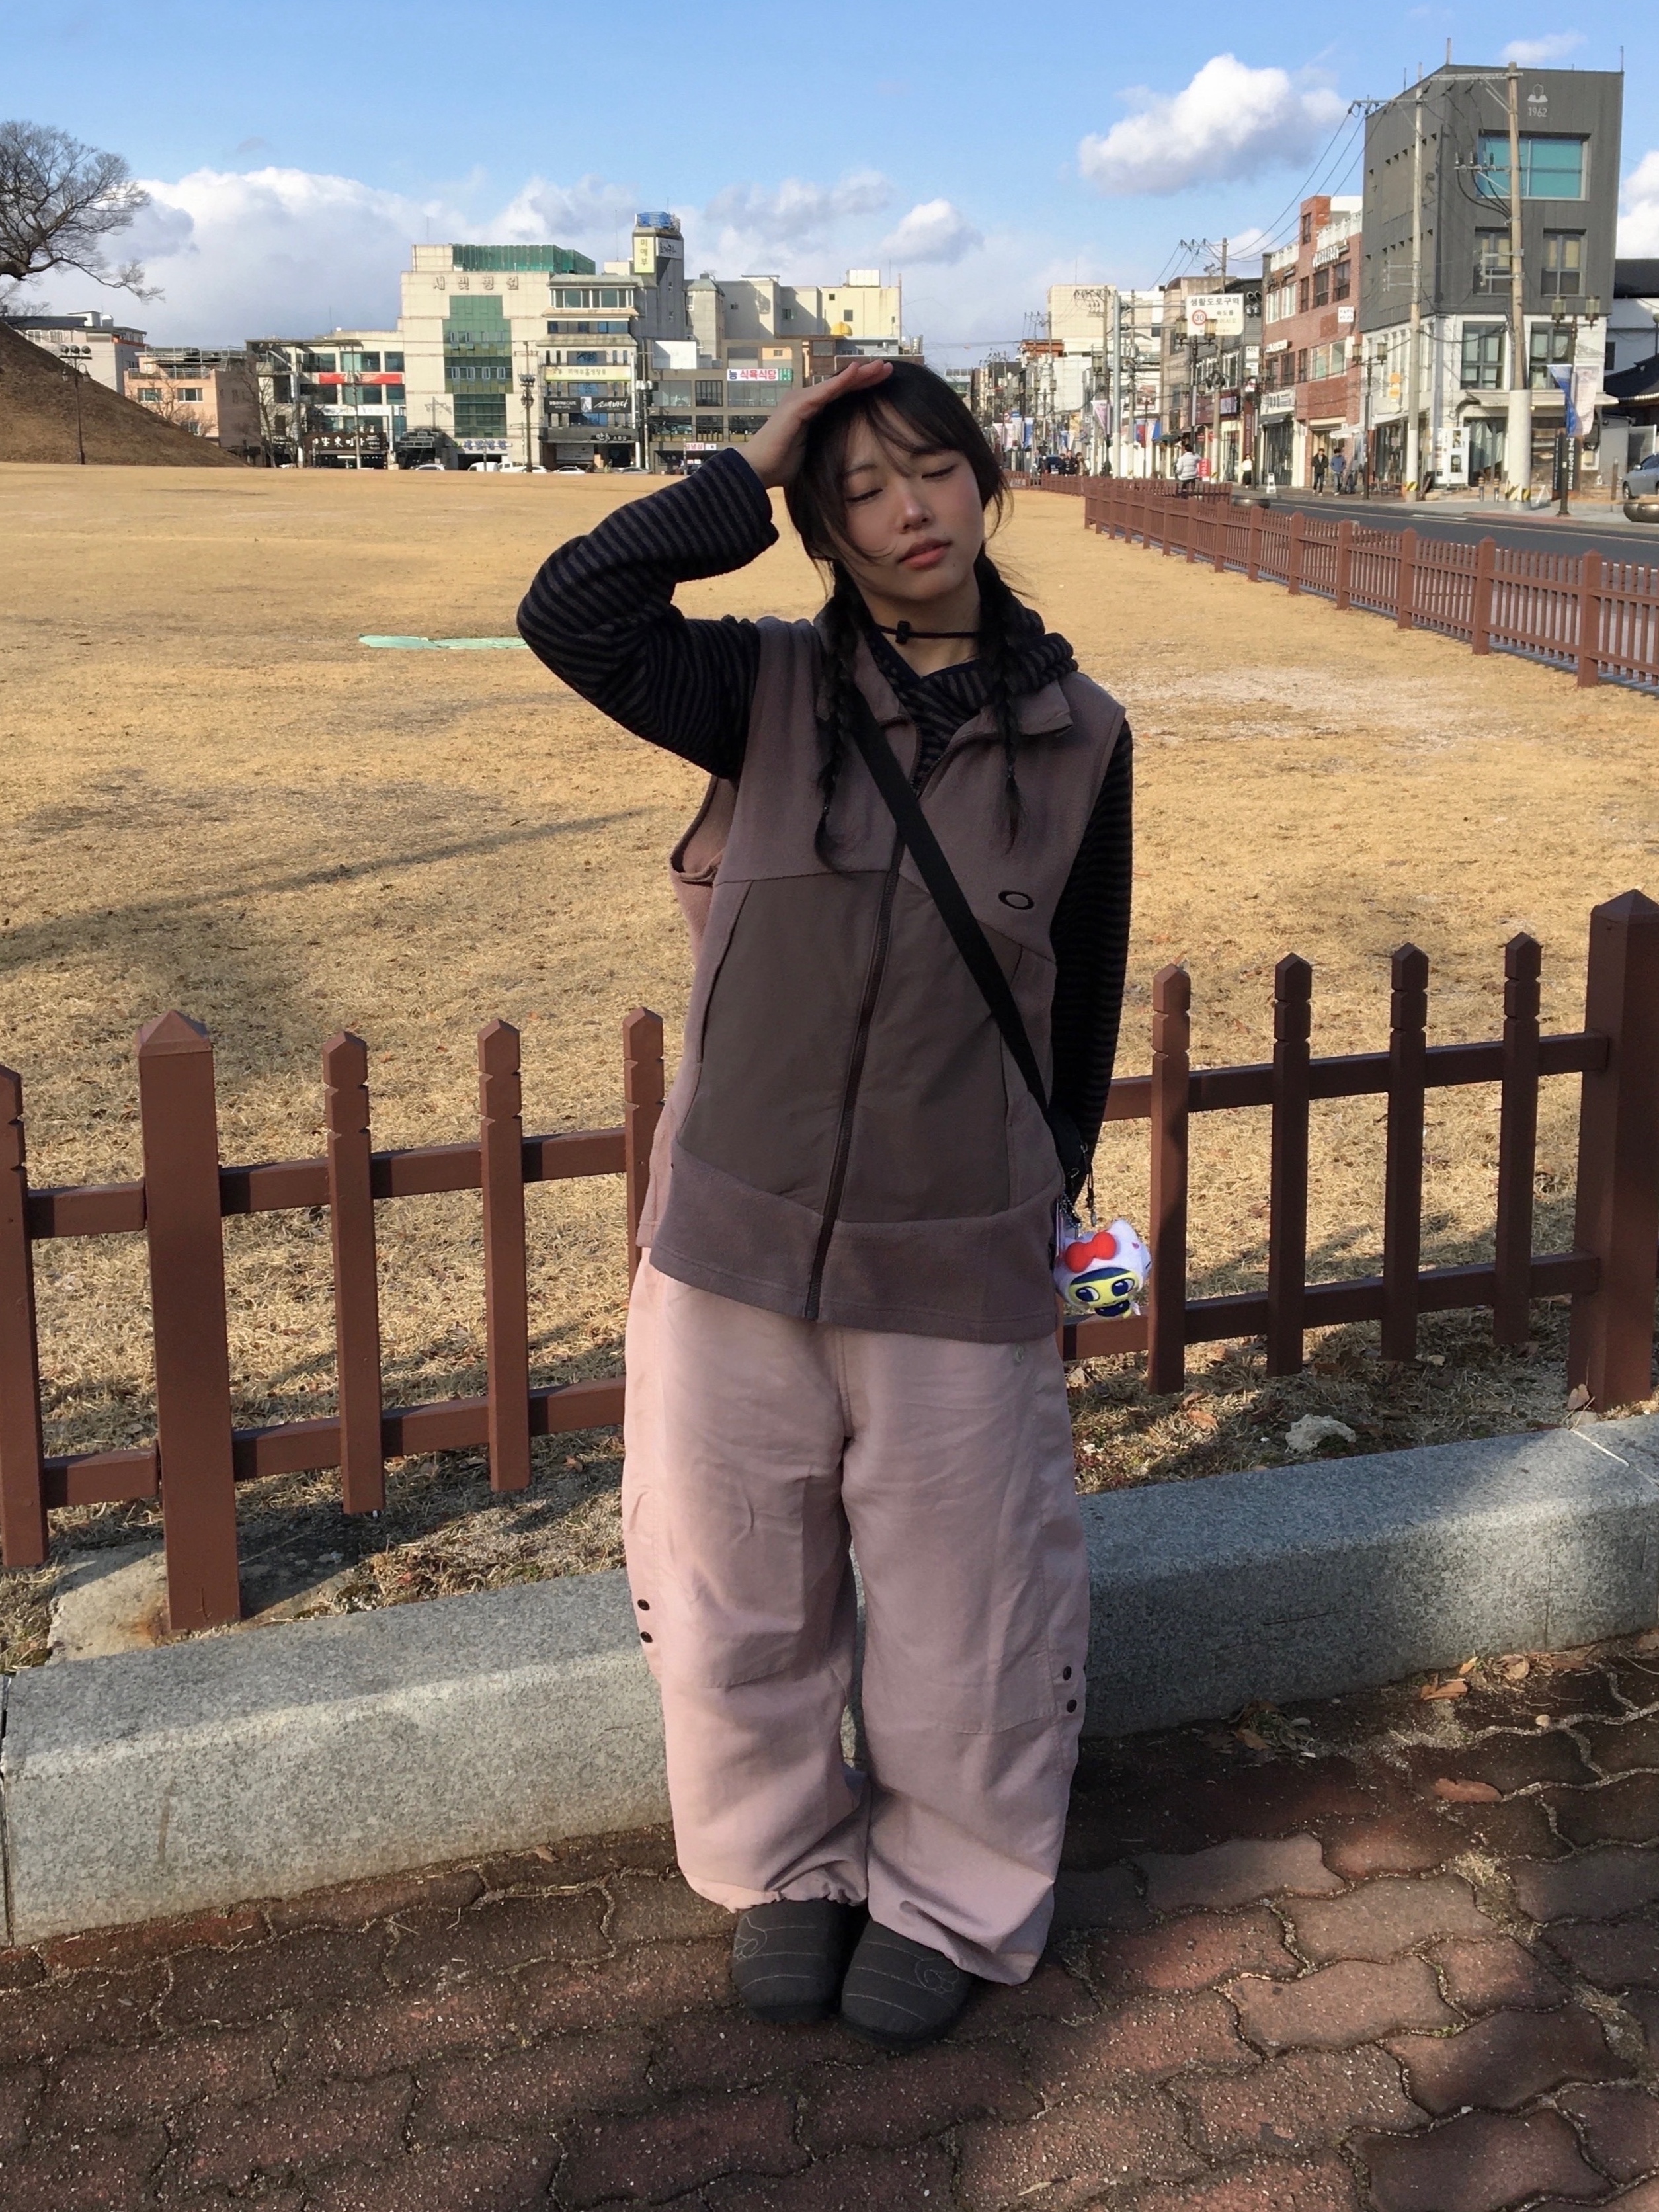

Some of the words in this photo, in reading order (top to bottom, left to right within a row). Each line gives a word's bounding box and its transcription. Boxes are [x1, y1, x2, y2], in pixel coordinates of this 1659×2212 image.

[1528, 106, 1548, 118] 1962
[433, 276, 519, 290] 새빛병원
[1190, 297, 1240, 306] 생활도로구역
[740, 370, 776, 380] 식육식당
